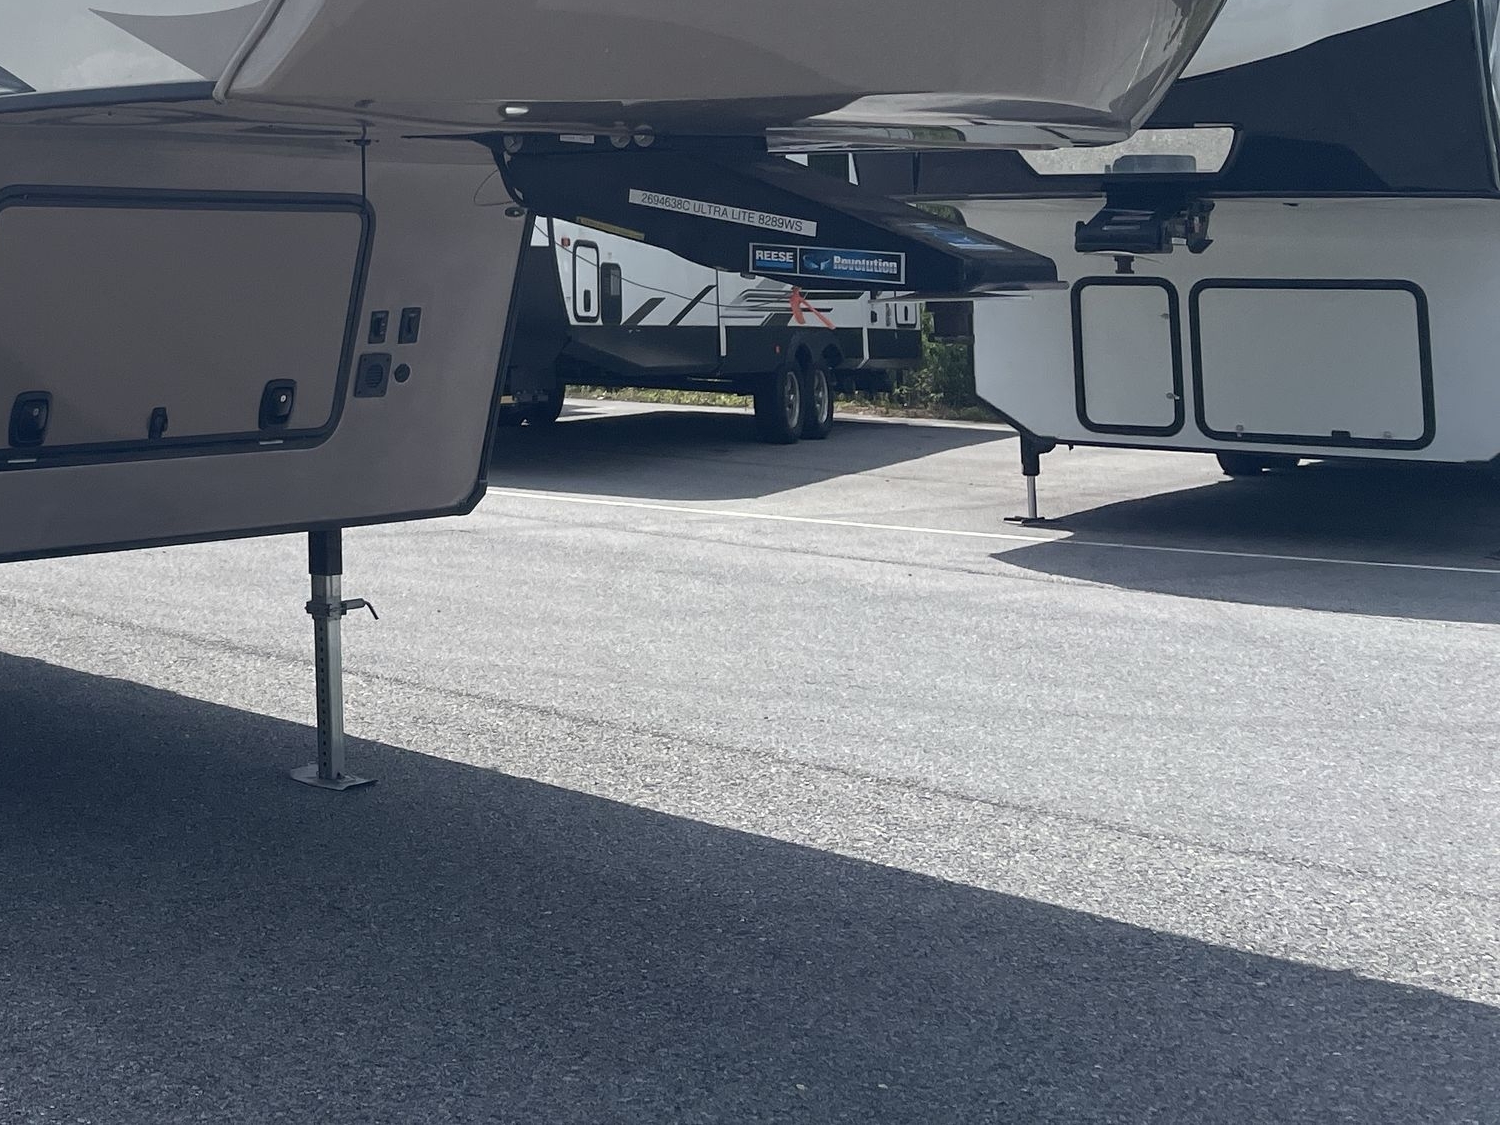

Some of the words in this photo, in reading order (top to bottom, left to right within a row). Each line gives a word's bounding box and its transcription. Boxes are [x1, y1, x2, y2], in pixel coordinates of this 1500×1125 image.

[641, 192, 690, 211] 2694638C
[693, 203, 729, 219] ULTRA
[731, 209, 755, 223] LITE
[757, 214, 803, 232] 8289WS
[755, 249, 794, 263] REESE
[833, 255, 898, 275] Revolution
